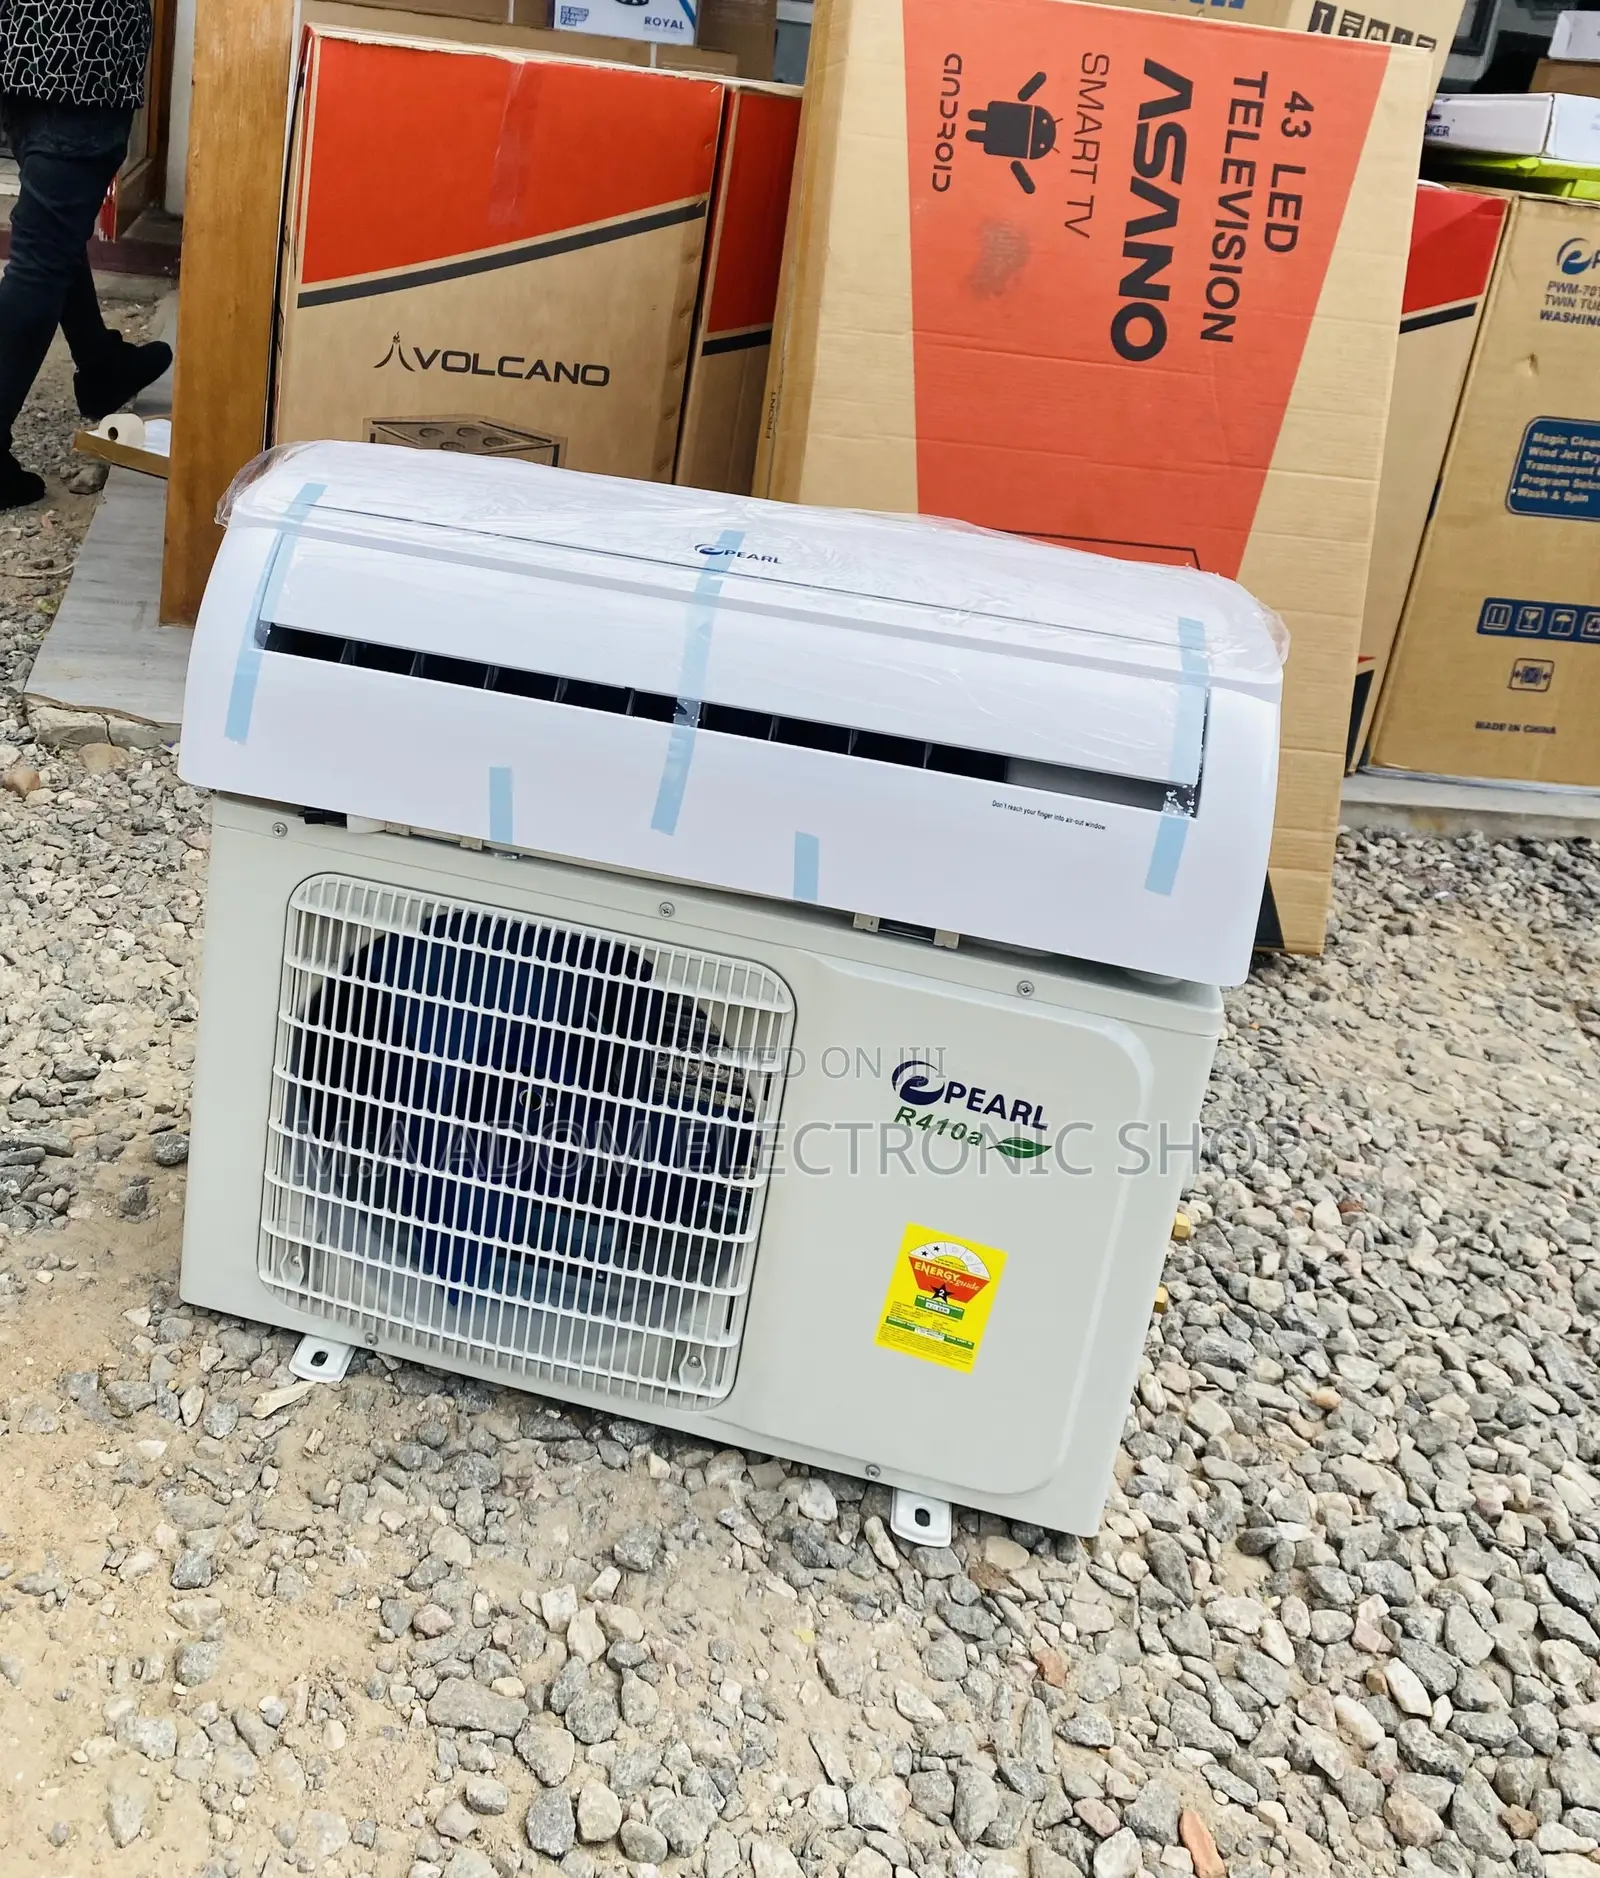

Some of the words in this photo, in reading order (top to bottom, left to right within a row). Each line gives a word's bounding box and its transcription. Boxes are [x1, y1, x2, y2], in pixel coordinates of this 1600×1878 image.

[644, 16, 685, 30] ROYAL
[1069, 52, 1110, 185] SMART
[1280, 91, 1315, 139] 43
[1063, 195, 1095, 239] TV
[1110, 58, 1194, 362] ASANO
[1200, 71, 1269, 343] TELEVISION
[1263, 163, 1307, 253] LED
[1544, 294, 1577, 308] TWIN
[413, 346, 611, 387] VOLCANO
[1529, 447, 1558, 457] Wind
[1560, 449, 1579, 459] Jet
[1532, 433, 1568, 445] Magic
[1521, 474, 1570, 486] Program
[1526, 460, 1594, 474] Transparent
[1517, 488, 1548, 498] Wash
[1563, 491, 1589, 503] Spin
[723, 549, 783, 565] PEARL
[1476, 721, 1506, 731] MADE
[1508, 723, 1521, 732] IN
[1523, 724, 1557, 734] CHINA
[1007, 803, 1023, 813] reach
[1023, 808, 1037, 816] your
[1037, 810, 1053, 820] finger
[1053, 813, 1065, 822] into
[1084, 820, 1106, 831] window
[943, 1080, 1049, 1132] PEARL
[893, 1105, 984, 1146] R410a
[913, 1260, 961, 1283] ENERGY
[954, 1279, 981, 1292] guide
[938, 1289, 946, 1297] 2
